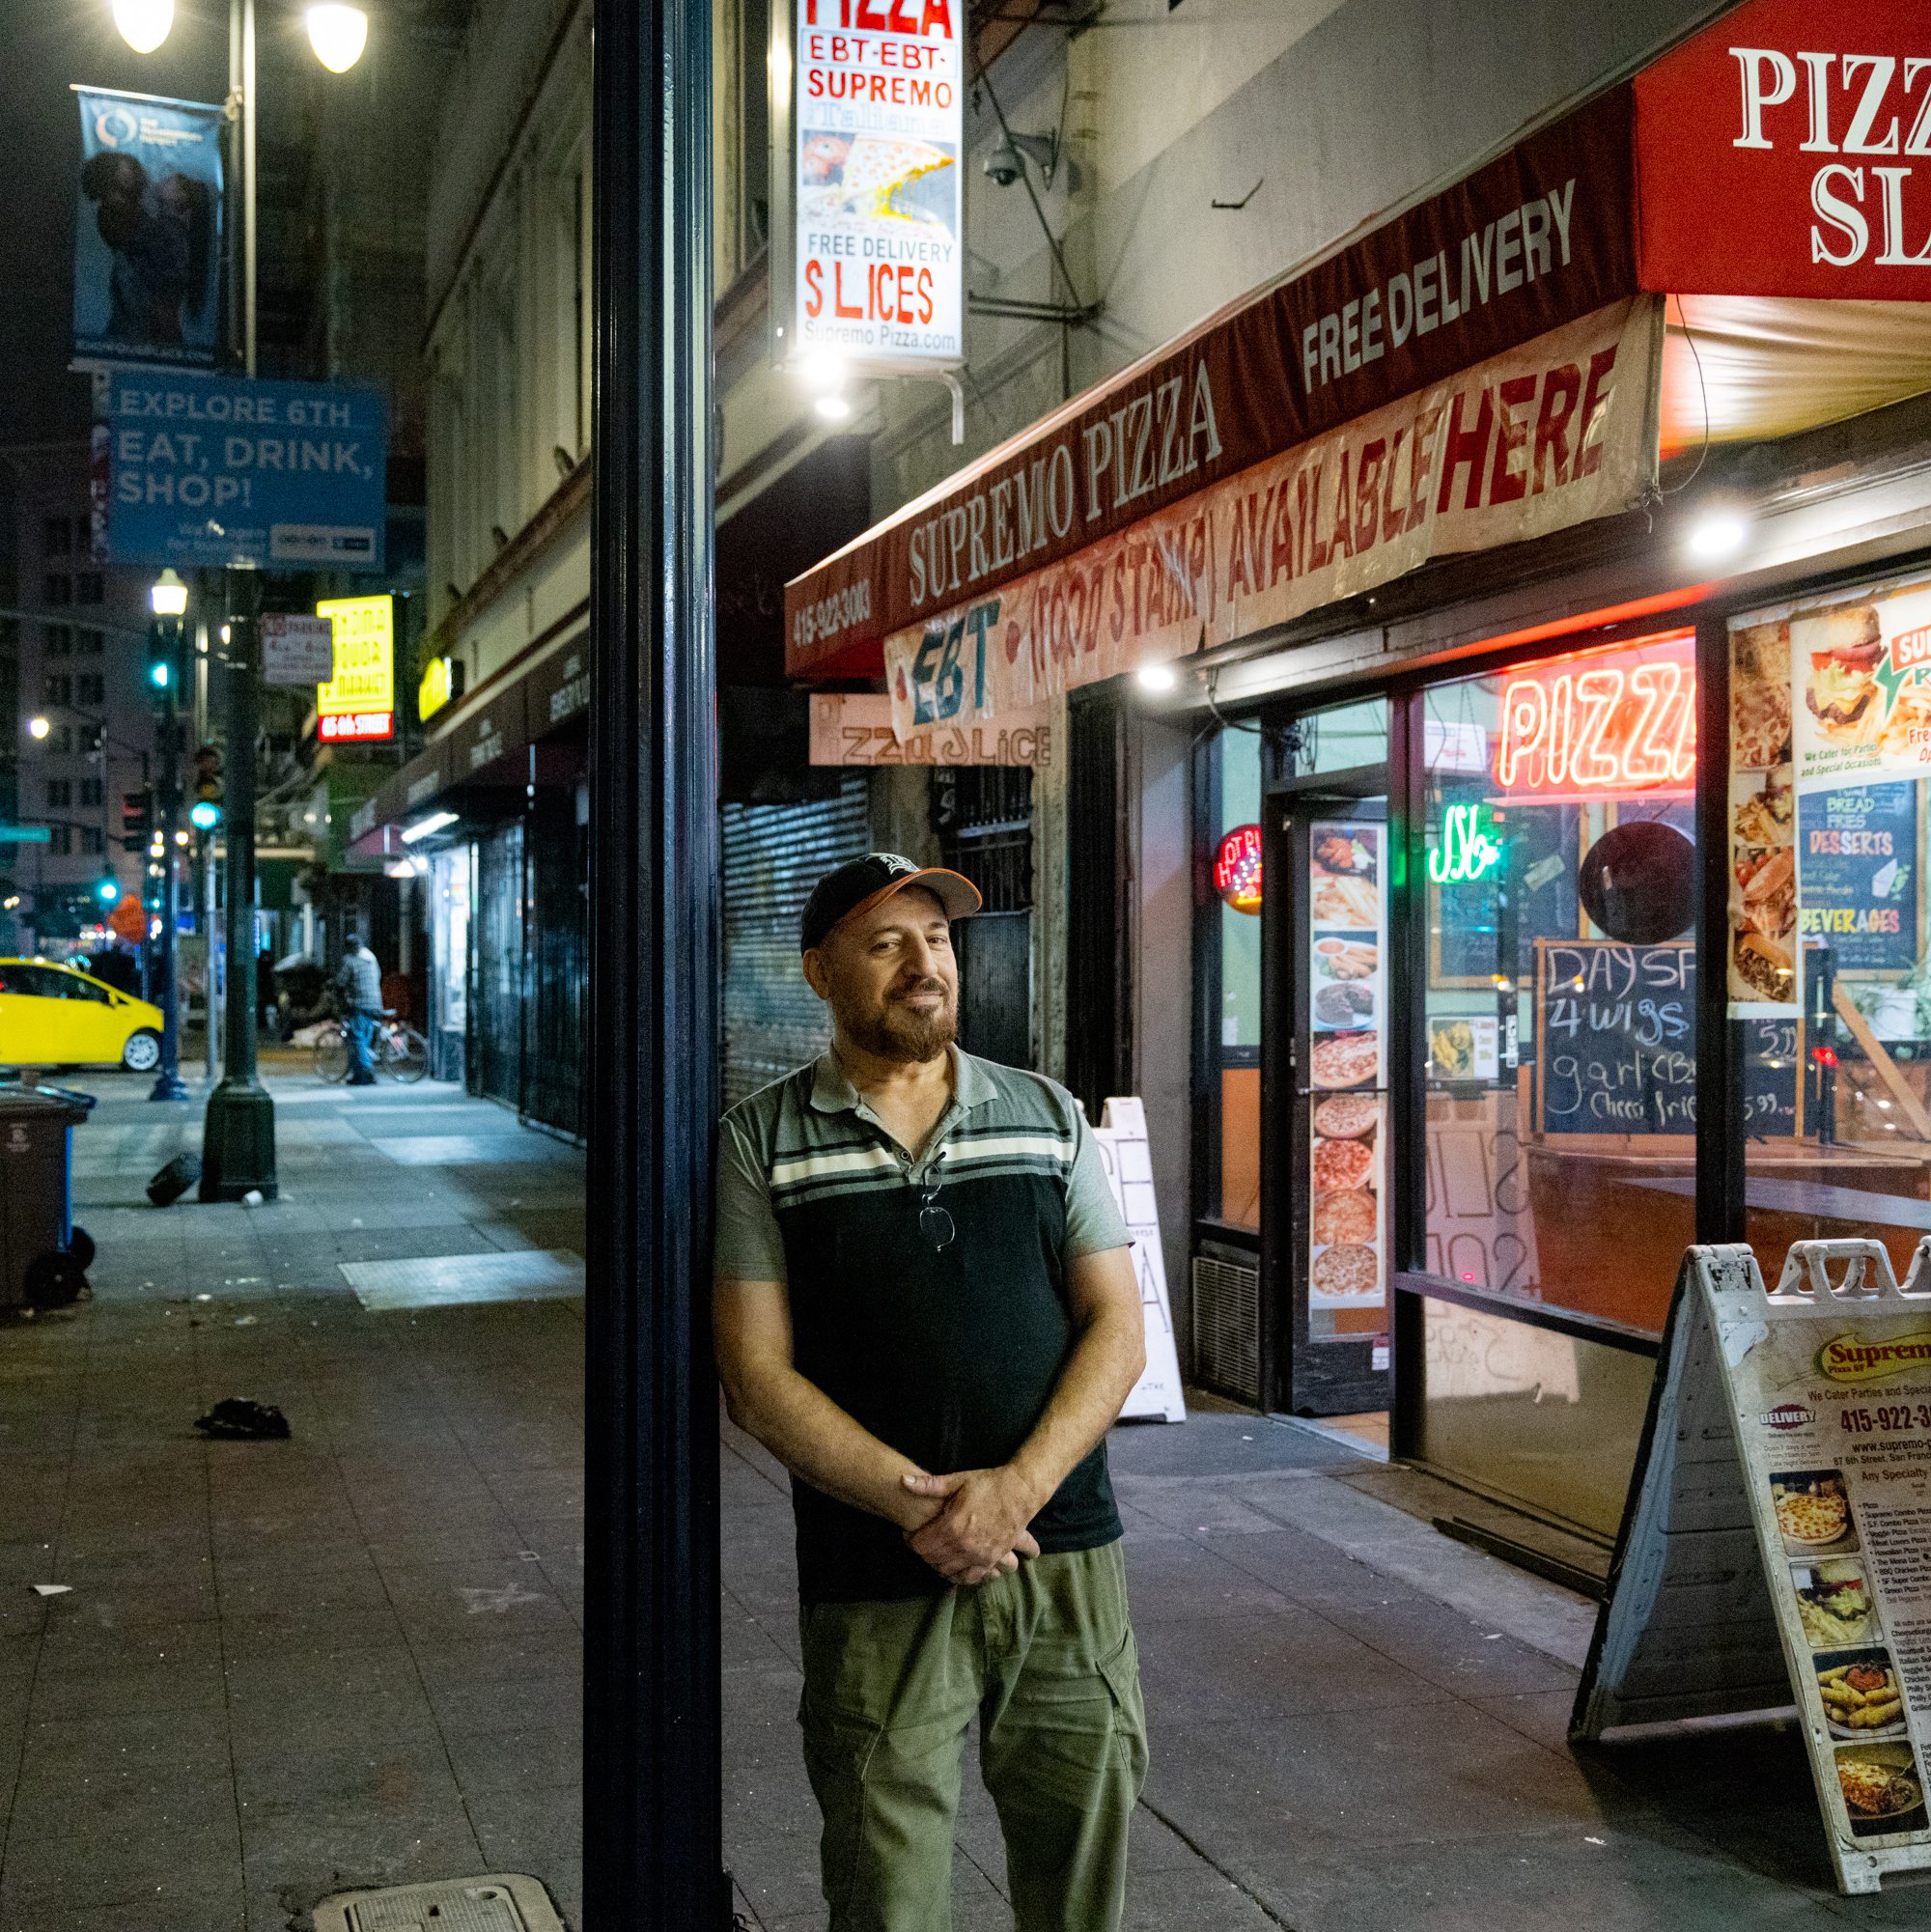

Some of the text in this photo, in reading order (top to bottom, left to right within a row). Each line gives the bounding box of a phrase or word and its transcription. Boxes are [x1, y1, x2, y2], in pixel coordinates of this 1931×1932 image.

[808, 69, 953, 109] SUPREMO
[807, 233, 953, 264] FREE DELIVERY
[805, 259, 934, 325] SLICES
[1302, 179, 1576, 395] FREE DELIVERY
[804, 320, 956, 351] Supremo Pizza.com
[119, 390, 351, 428] EXPLORE 6TH
[118, 431, 375, 481] EAT, DRINK,
[117, 471, 253, 508] SHOP!
[909, 359, 1223, 606] SUPREMO PIZZA
[911, 599, 1001, 725] EBT
[1226, 406, 1441, 603] AVAILABLE
[1436, 342, 1618, 515] HERE
[1819, 749, 1838, 760] Cater
[1841, 746, 1852, 757] for
[1801, 756, 1882, 777] and Special Occasions
[1827, 797, 1875, 813] BREAD
[1827, 813, 1867, 828] FRIES
[1808, 829, 1893, 855] DESSERTS
[1217, 835, 1243, 887] HOT
[1801, 908, 1900, 934] BEVERAGES
[1828, 1363, 1865, 1373] Pizza SF
[1808, 1389, 1823, 1401] We
[1824, 1389, 1849, 1400] Cater
[1851, 1387, 1883, 1399] Parties
[1885, 1386, 1902, 1396] and
[1759, 1410, 1816, 1425] DELIVERY
[1840, 1404, 1931, 1433] 415-922-3
[1845, 1456, 1860, 1466] 6th
[1889, 1452, 1906, 1462] San
[1861, 1468, 1928, 1483] Any Specialty
[1904, 1674, 1930, 1683] Chicken
[1906, 1685, 1923, 1694] Philly
[1908, 1694, 1926, 1703] Philly
